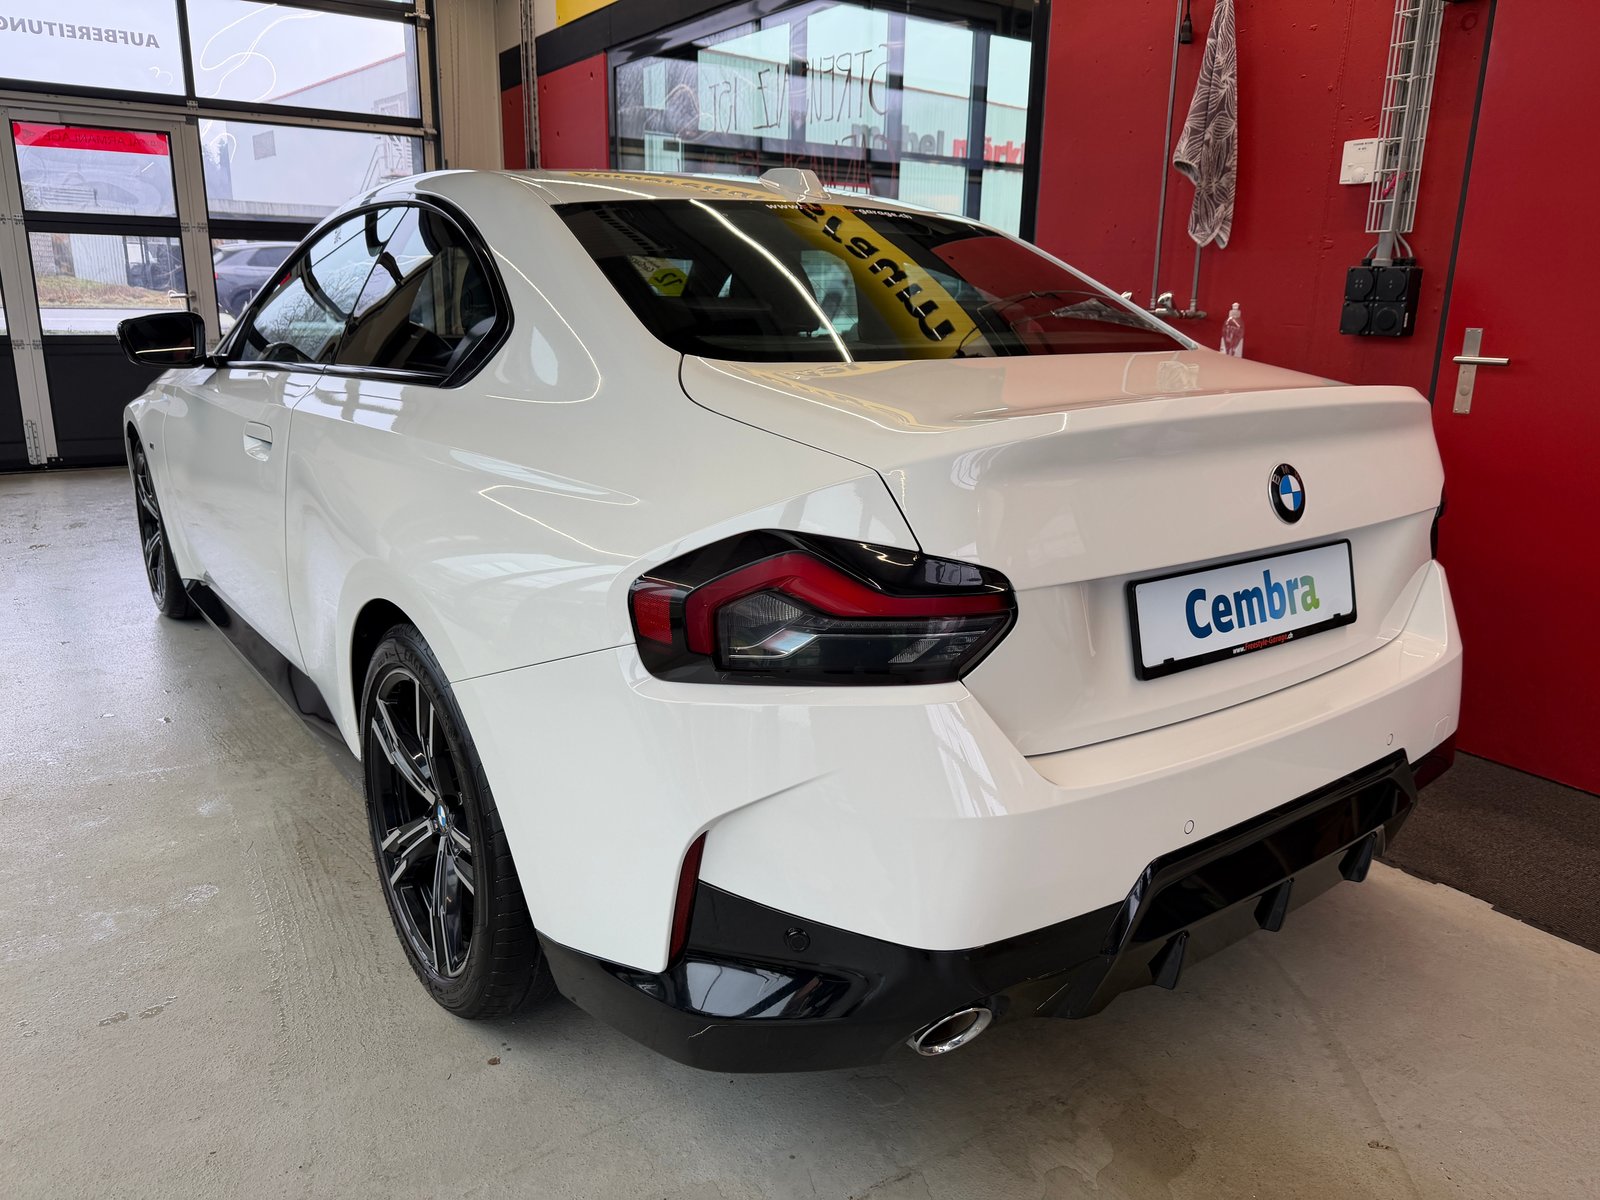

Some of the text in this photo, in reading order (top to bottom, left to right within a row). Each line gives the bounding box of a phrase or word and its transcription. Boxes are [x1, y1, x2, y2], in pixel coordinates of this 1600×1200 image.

[852, 123, 945, 156] mbel
[765, 203, 913, 220] www.-garage.ch
[1185, 569, 1320, 639] Cembra
[1232, 631, 1294, 655] www.Freestyle-Garage.ch
